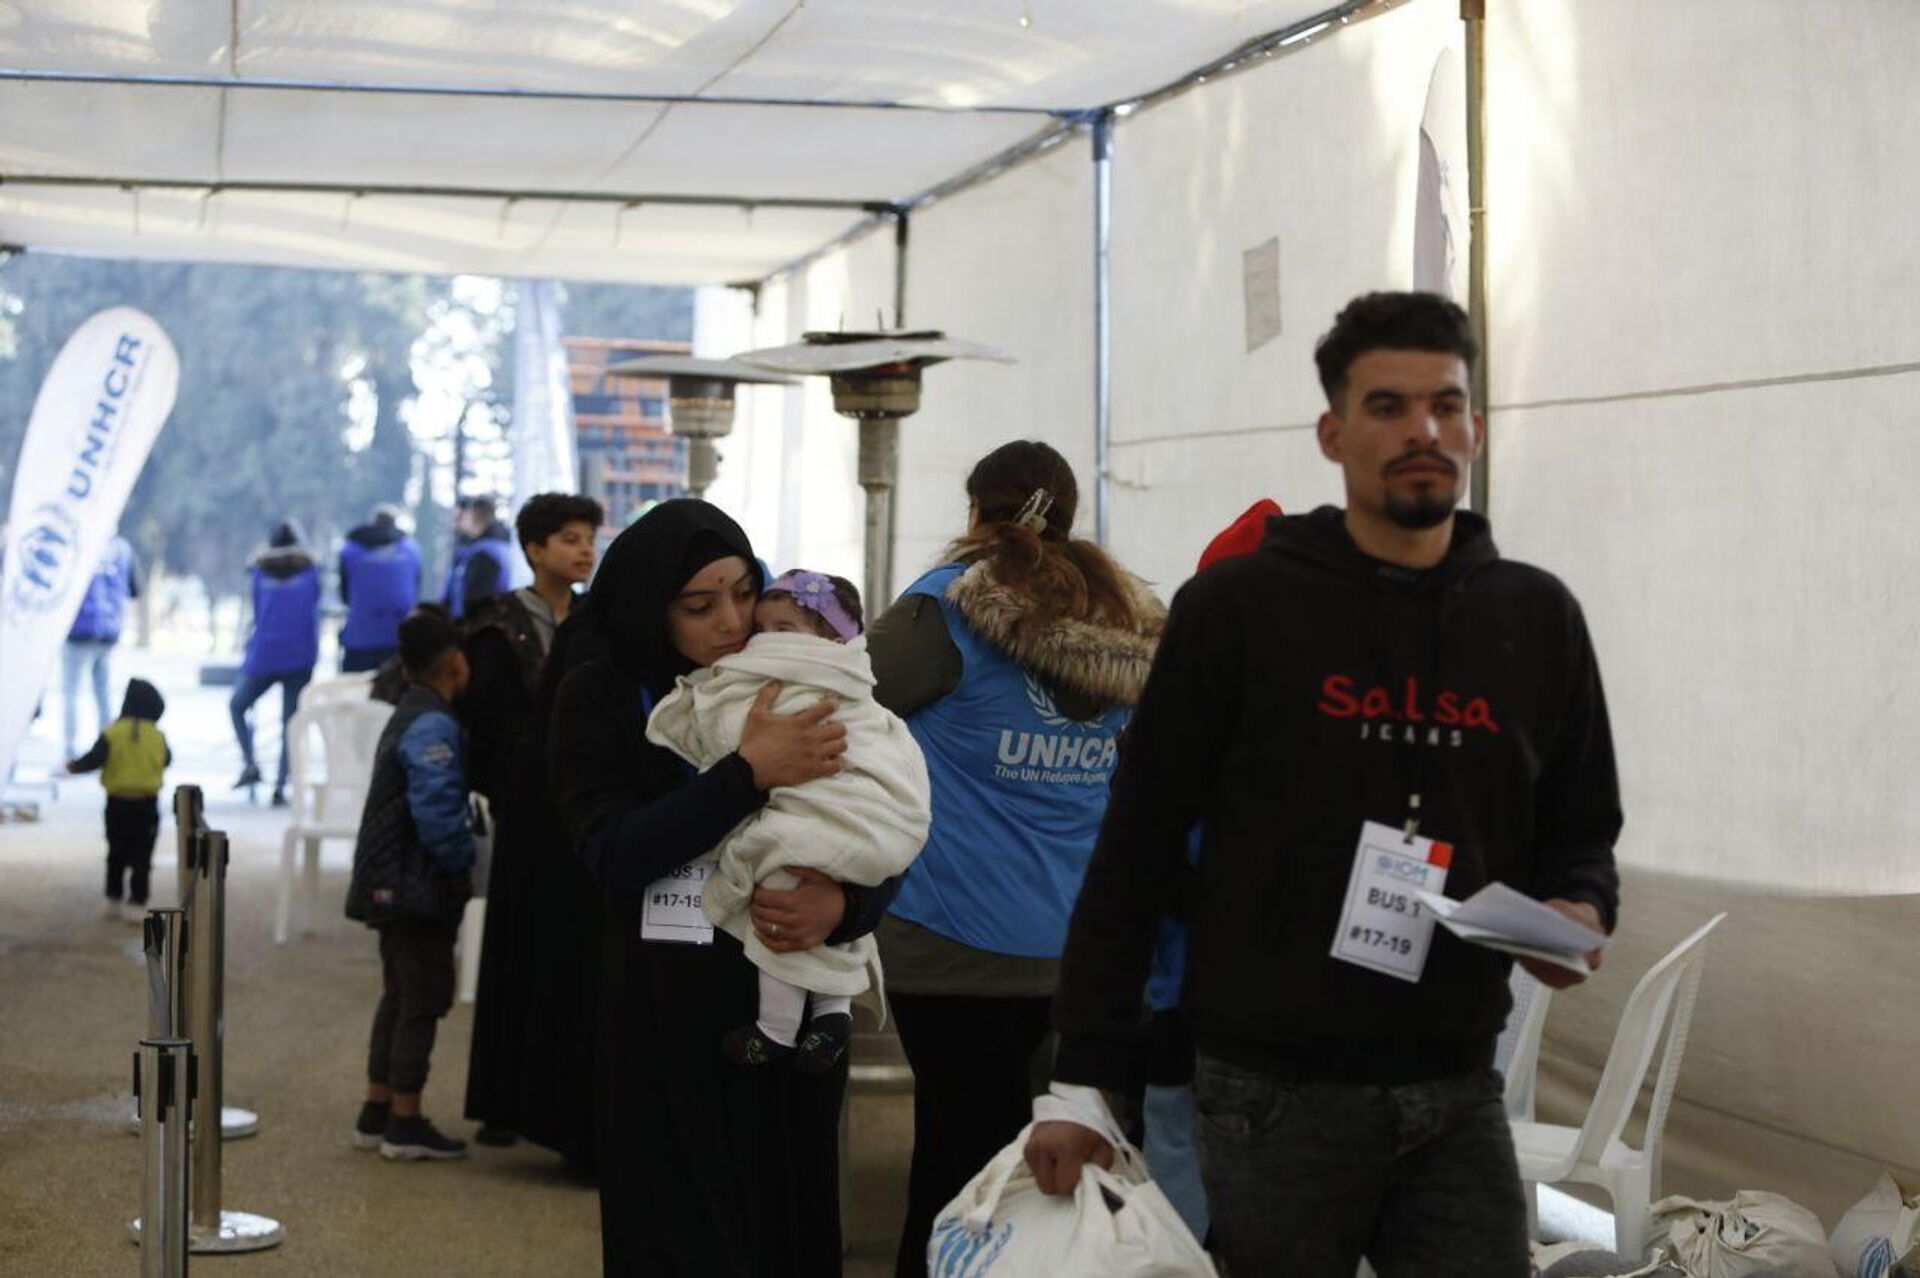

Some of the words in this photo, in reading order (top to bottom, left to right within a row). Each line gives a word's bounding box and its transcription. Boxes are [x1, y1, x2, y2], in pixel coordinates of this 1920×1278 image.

[68, 333, 140, 498] UNHCR
[1318, 673, 1501, 733] Salsa
[1361, 723, 1462, 746] JEANS
[999, 730, 1117, 769] UNHCR
[995, 764, 1018, 779] The
[1020, 768, 1039, 781] UN
[1041, 771, 1081, 784] Refugee
[665, 864, 693, 879] US
[653, 893, 702, 908] #17-19
[1368, 887, 1408, 912] BUS
[1350, 926, 1412, 954] #17-19
